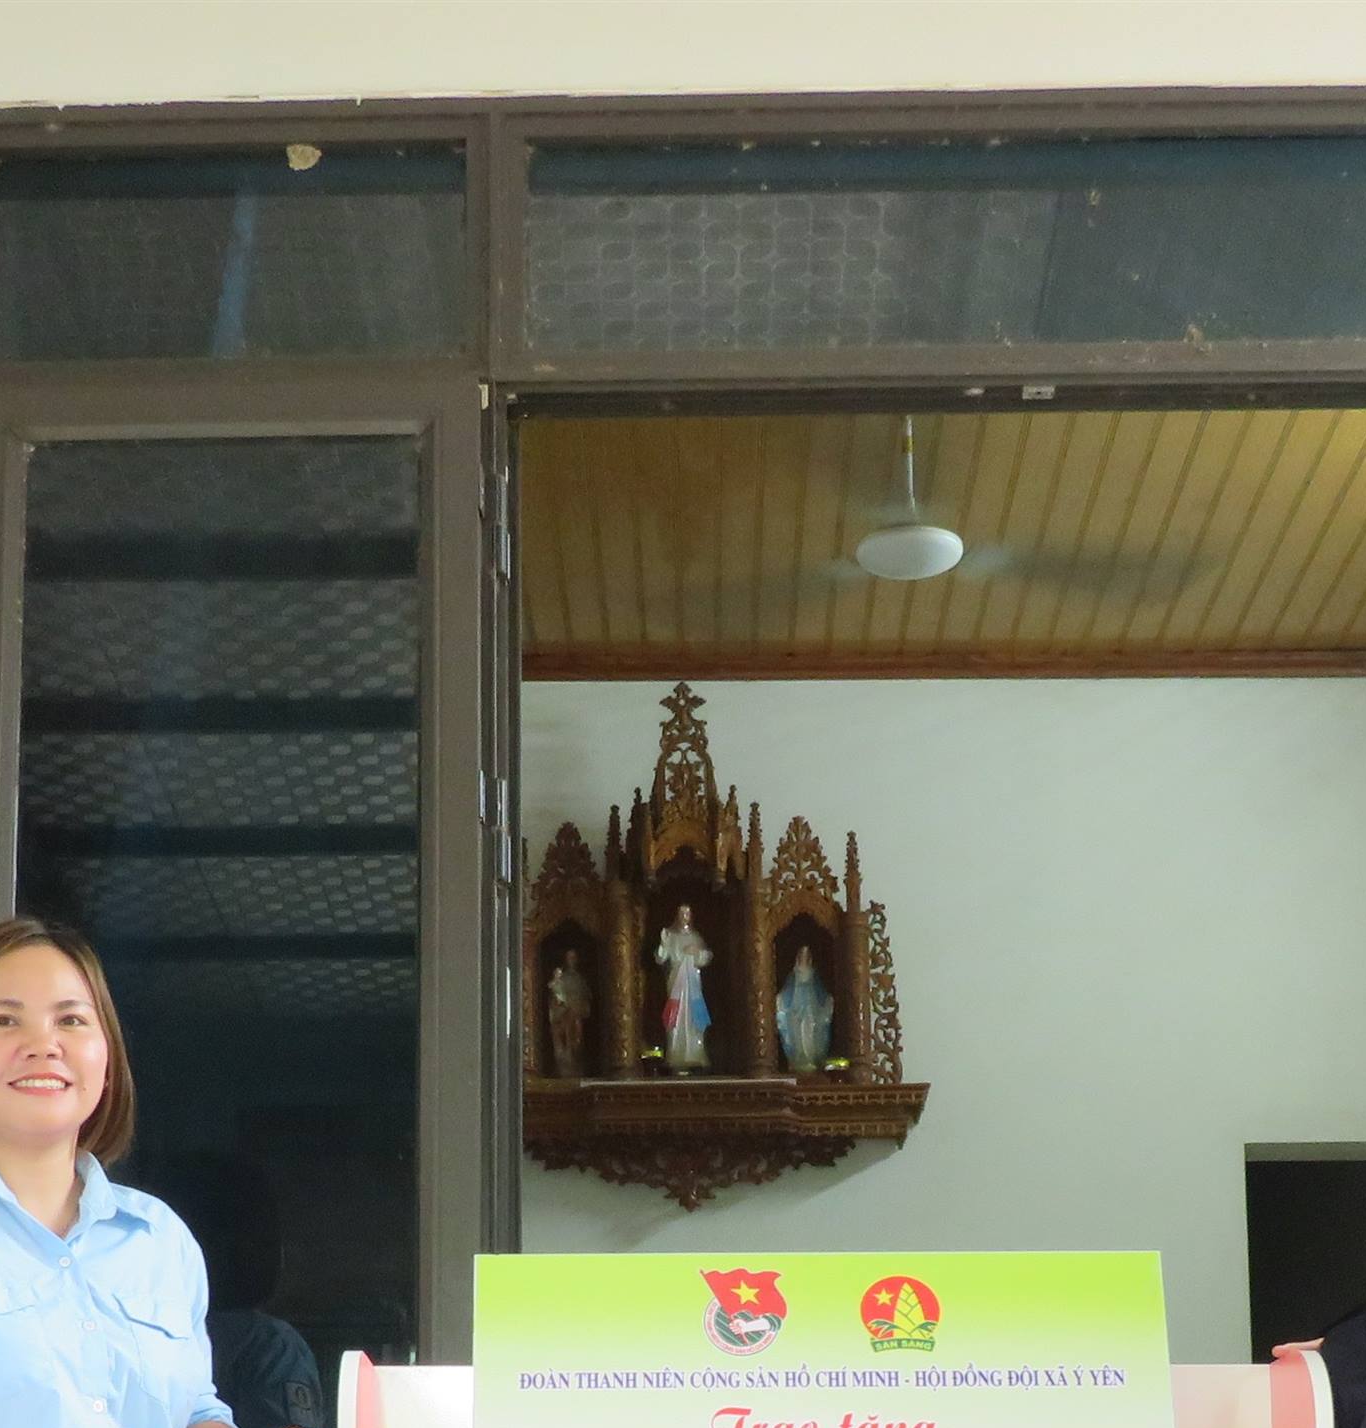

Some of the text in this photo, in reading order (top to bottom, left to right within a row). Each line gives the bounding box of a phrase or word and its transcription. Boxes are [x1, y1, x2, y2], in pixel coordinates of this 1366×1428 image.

[519, 1367, 571, 1390] ĐOÀN
[575, 1371, 637, 1390] THANH
[642, 1367, 685, 1389] NIÊN
[689, 1366, 741, 1392] CỘNG
[745, 1366, 780, 1389] SẢN
[784, 1363, 811, 1388] HỒ
[815, 1366, 847, 1388] CHÍ
[852, 1370, 900, 1388] MINH
[915, 1365, 947, 1391] HỘI
[952, 1363, 1003, 1388] ĐỒNG
[1007, 1365, 1039, 1391] ĐỘI
[1044, 1366, 1068, 1387] XÃ
[1073, 1365, 1085, 1387] Ý
[1089, 1365, 1126, 1387] YÊN
